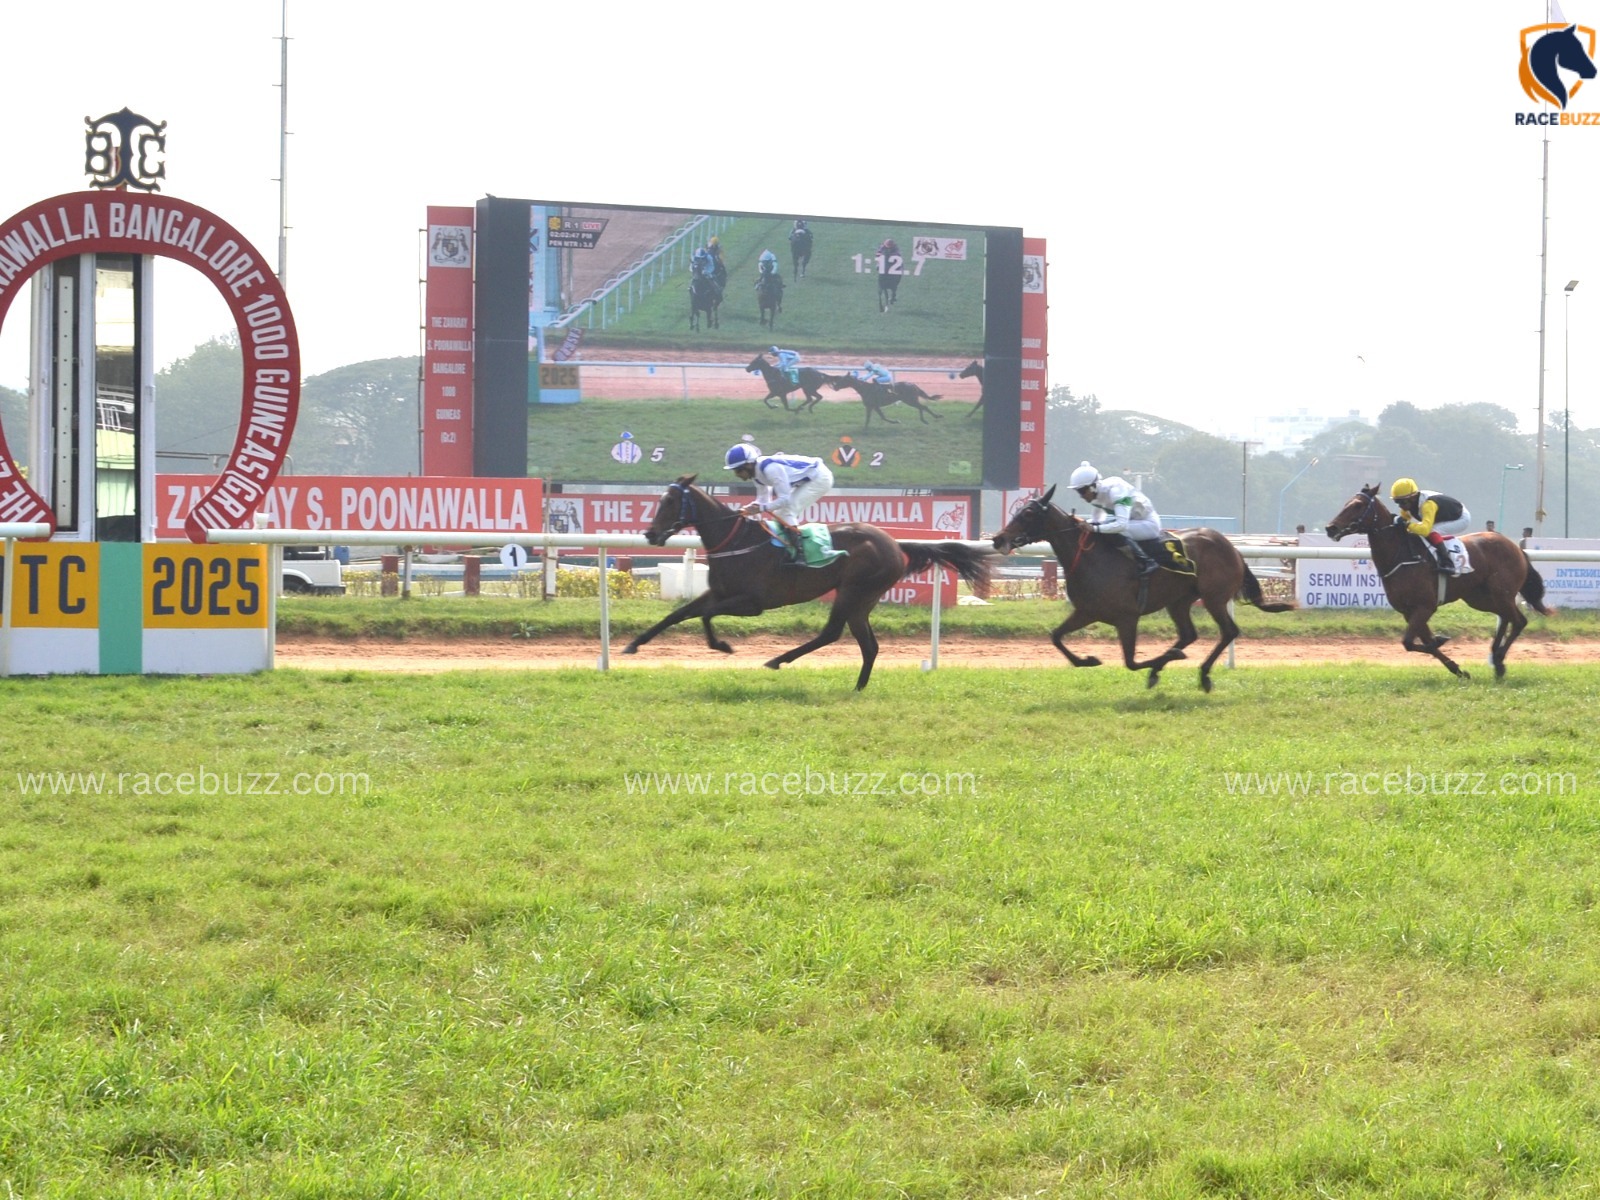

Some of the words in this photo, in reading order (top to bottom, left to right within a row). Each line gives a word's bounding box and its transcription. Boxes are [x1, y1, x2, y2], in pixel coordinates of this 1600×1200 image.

[851, 253, 926, 276] 1:12.7
[0, 203, 100, 295] AWALLA
[109, 203, 265, 298] BANGALORE
[243, 293, 290, 360] 1000
[651, 447, 664, 462] 5
[870, 452, 884, 466] 2
[306, 486, 331, 531] S.
[341, 486, 528, 531] POONAWALLA
[591, 500, 633, 522] THE
[509, 547, 518, 567] 1
[152, 556, 260, 616] 2025
[1309, 573, 1352, 587] SERUM
[1356, 574, 1383, 587] INST
[1543, 579, 1594, 589] OONAWALLA
[1306, 592, 1322, 606] OF
[1326, 592, 1360, 606] INDIA
[1363, 593, 1389, 607] PVT.
